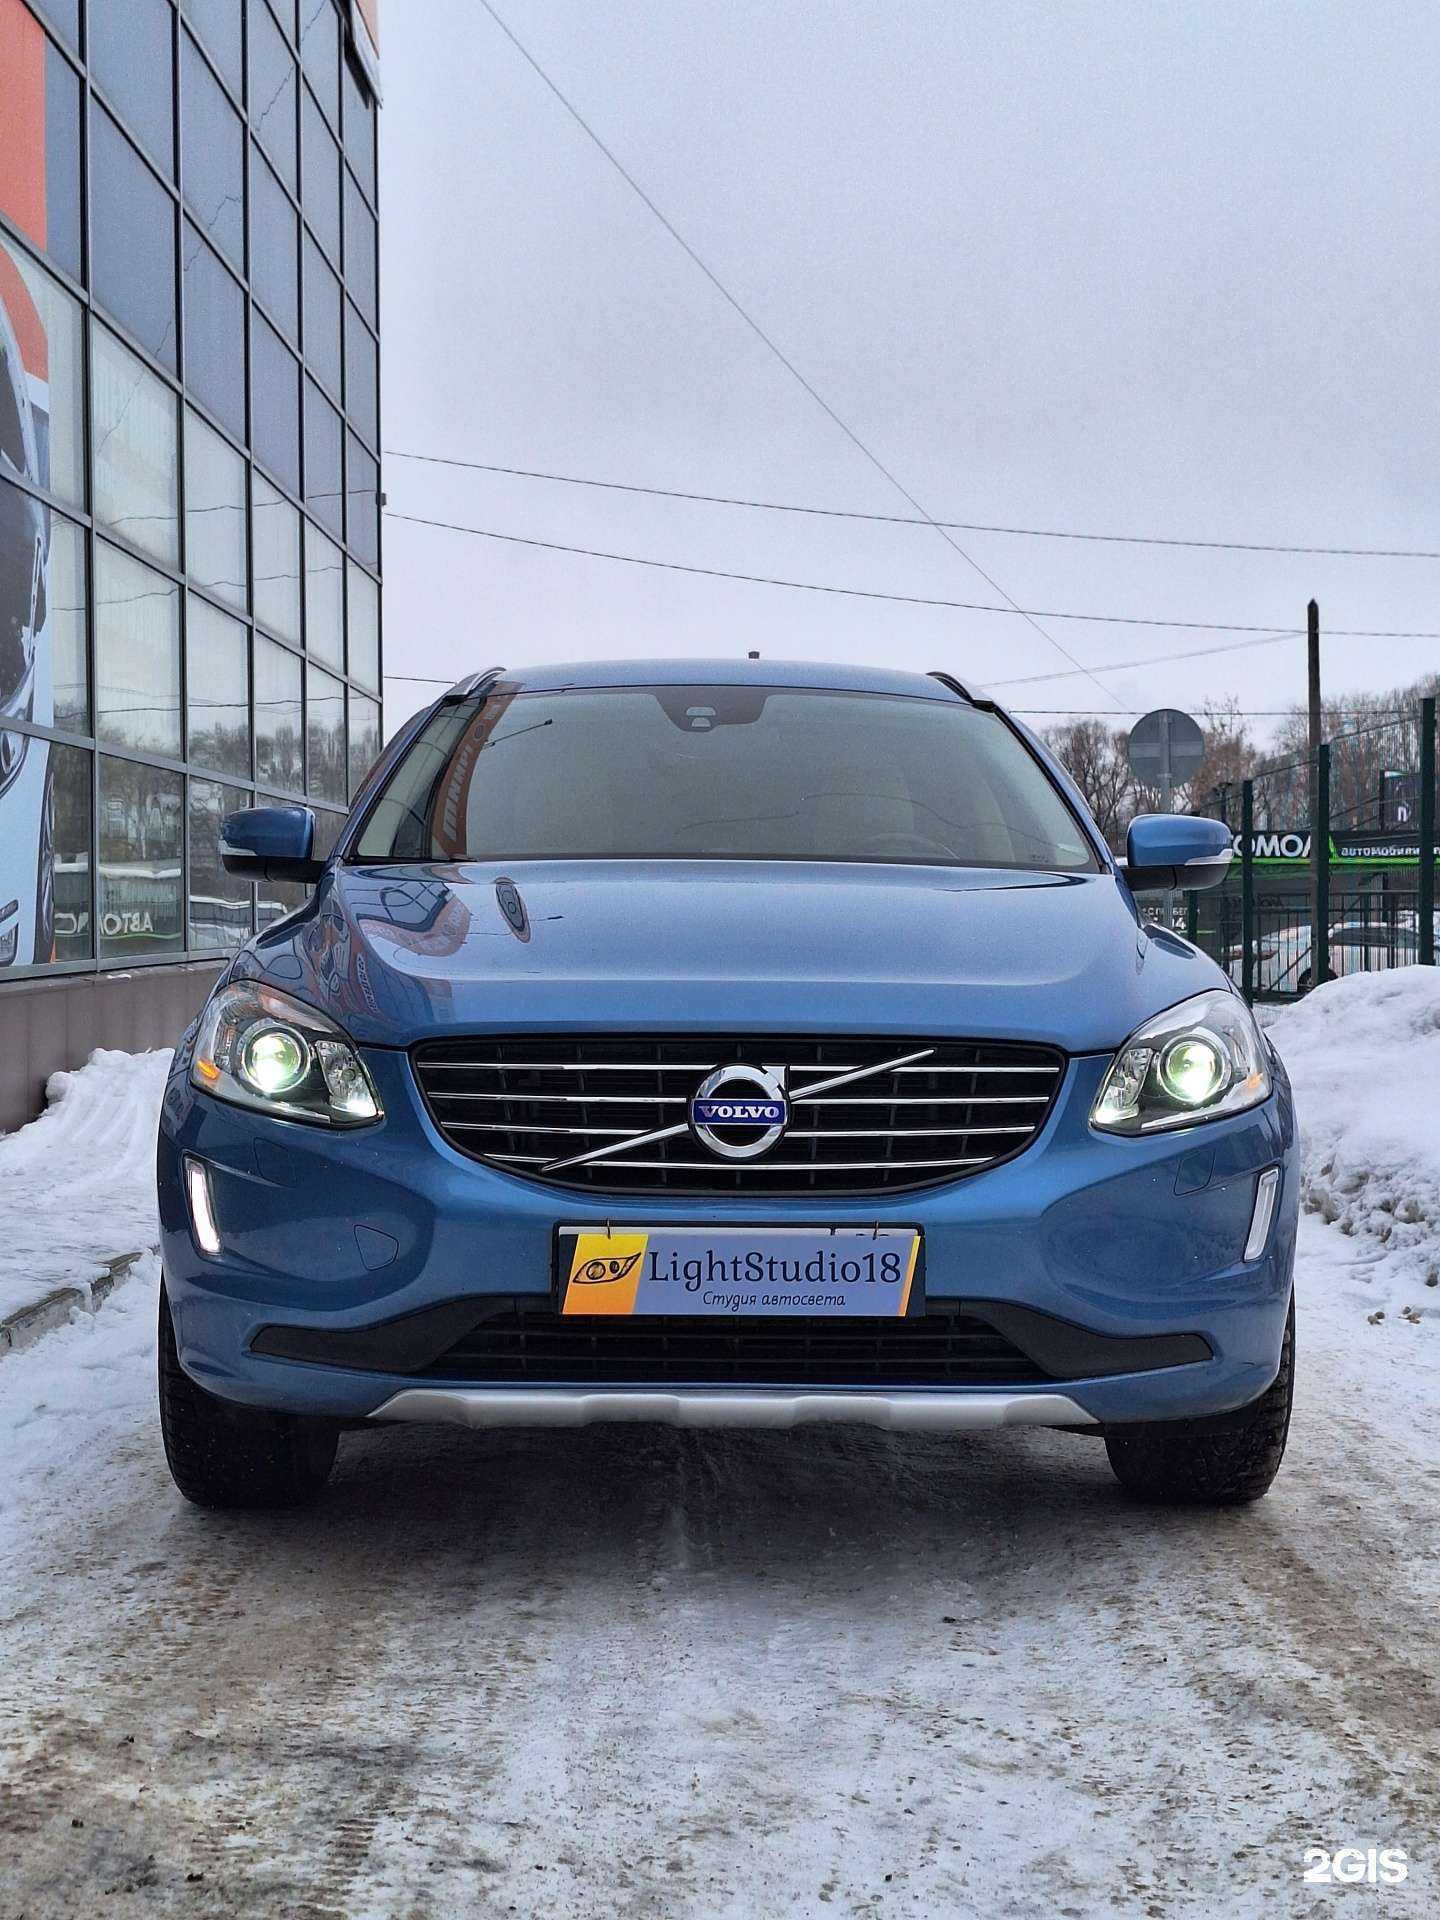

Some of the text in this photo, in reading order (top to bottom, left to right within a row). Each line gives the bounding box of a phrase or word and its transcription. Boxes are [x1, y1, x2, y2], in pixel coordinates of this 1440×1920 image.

[698, 1105, 780, 1119] VOLVO
[648, 1249, 901, 1292] LightStudio18
[703, 1291, 846, 1312] Студия автосвета
